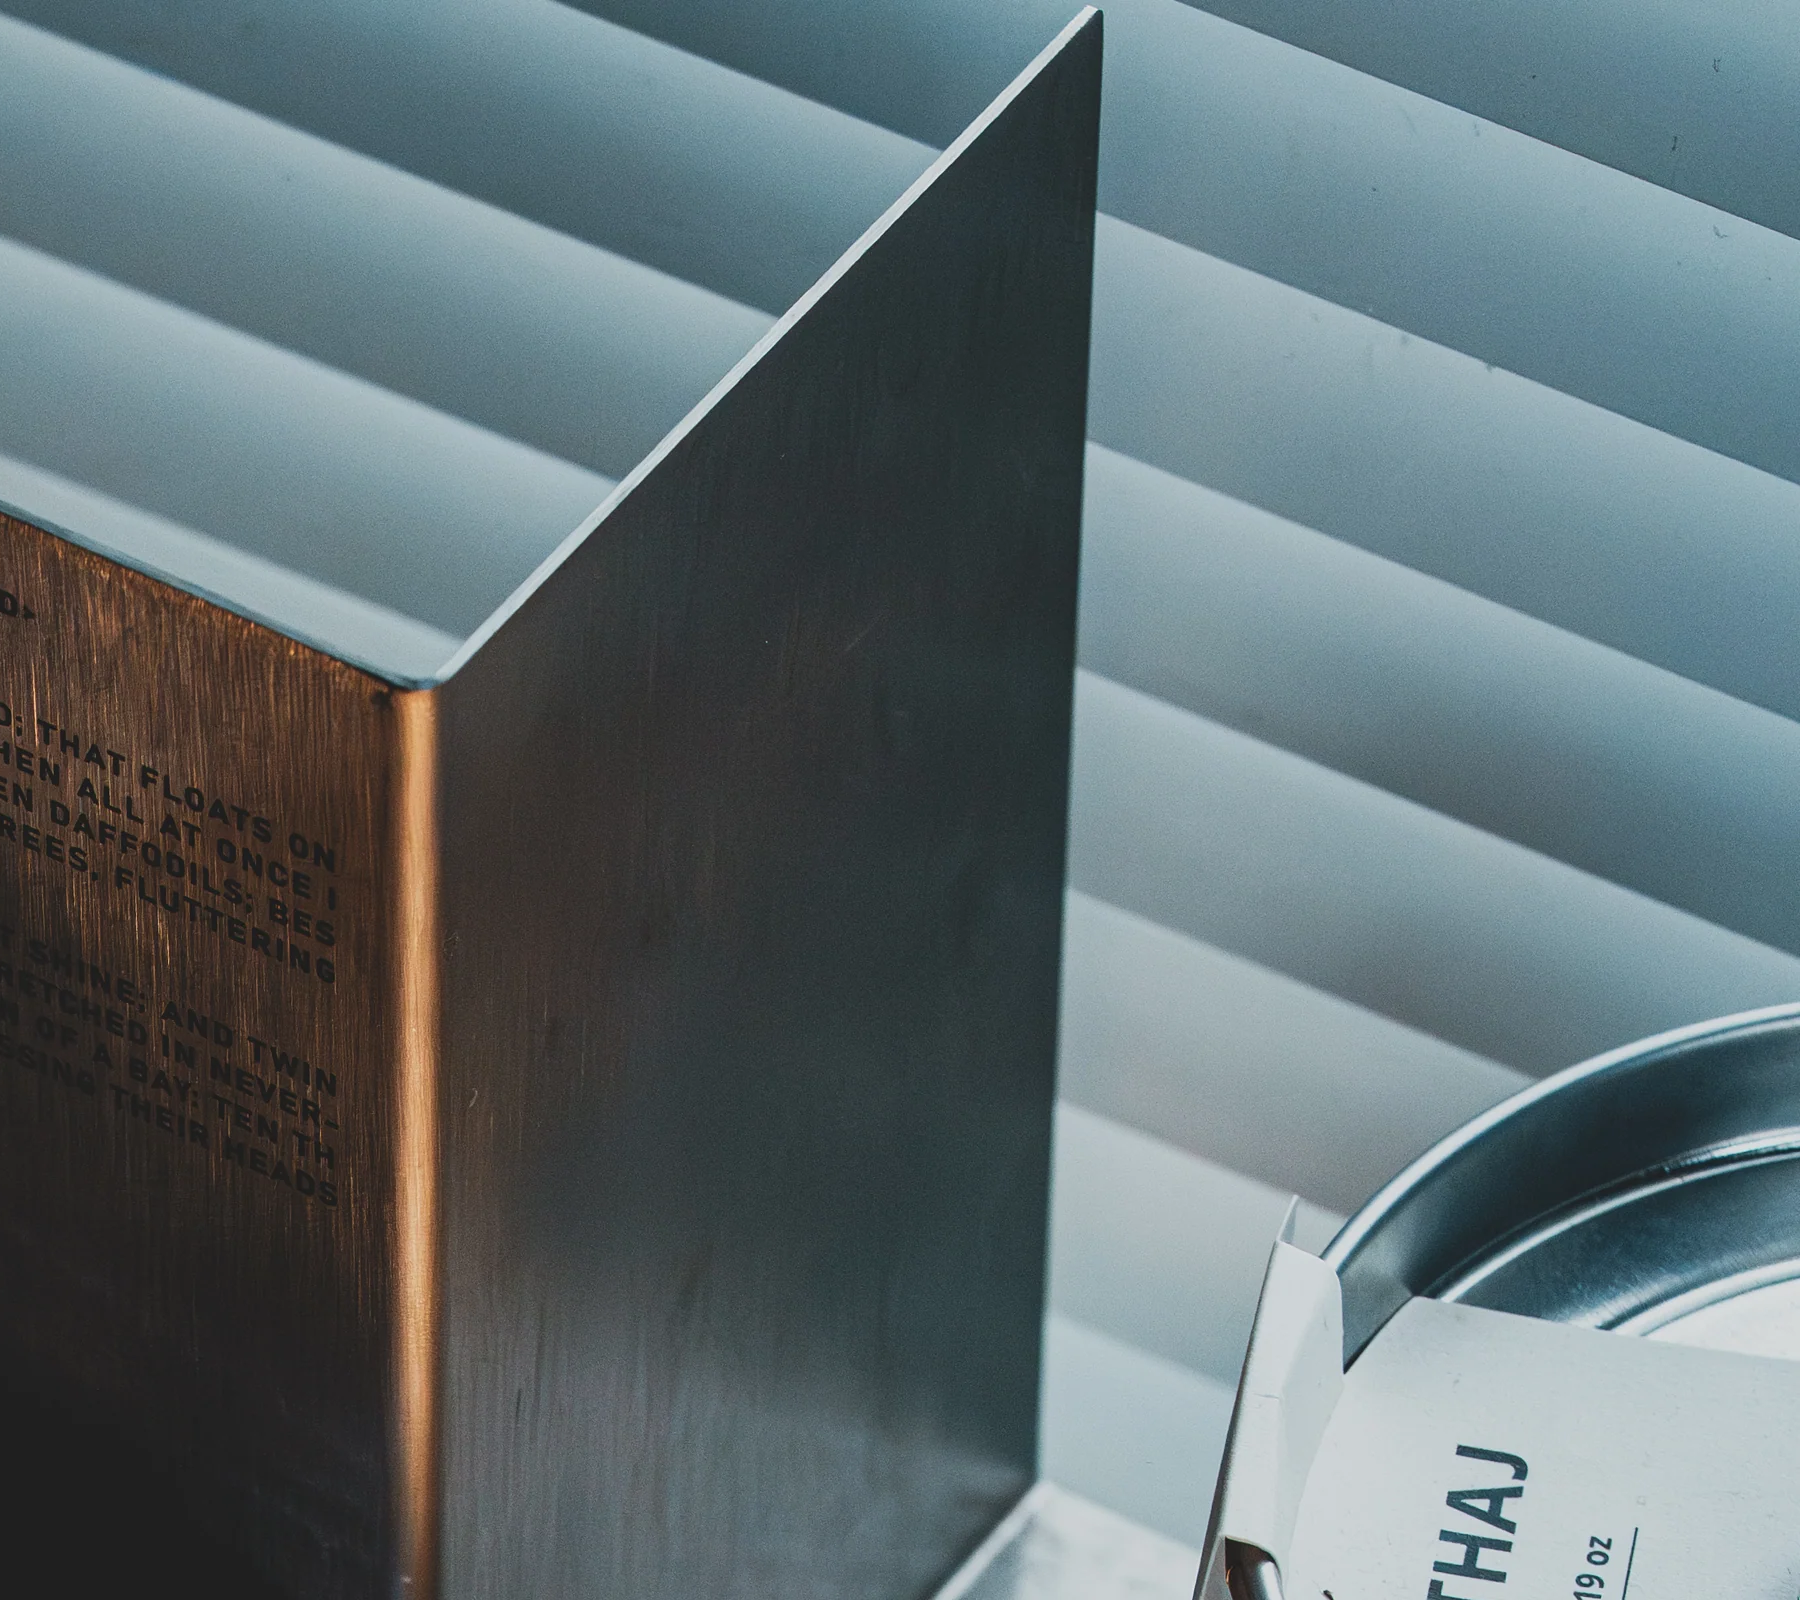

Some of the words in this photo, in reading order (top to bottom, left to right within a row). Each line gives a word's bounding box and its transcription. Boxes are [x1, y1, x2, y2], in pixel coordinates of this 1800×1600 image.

[36, 717, 127, 778] THAT
[140, 765, 273, 845] FLOATS
[288, 832, 336, 874] ON
[77, 777, 144, 825] ALL
[160, 813, 202, 848] AT
[216, 838, 311, 900] ONCE
[327, 886, 337, 911] I
[115, 866, 336, 985] FLUTTERING
[268, 899, 336, 948] BES
[1585, 1535, 1613, 1567] oz
